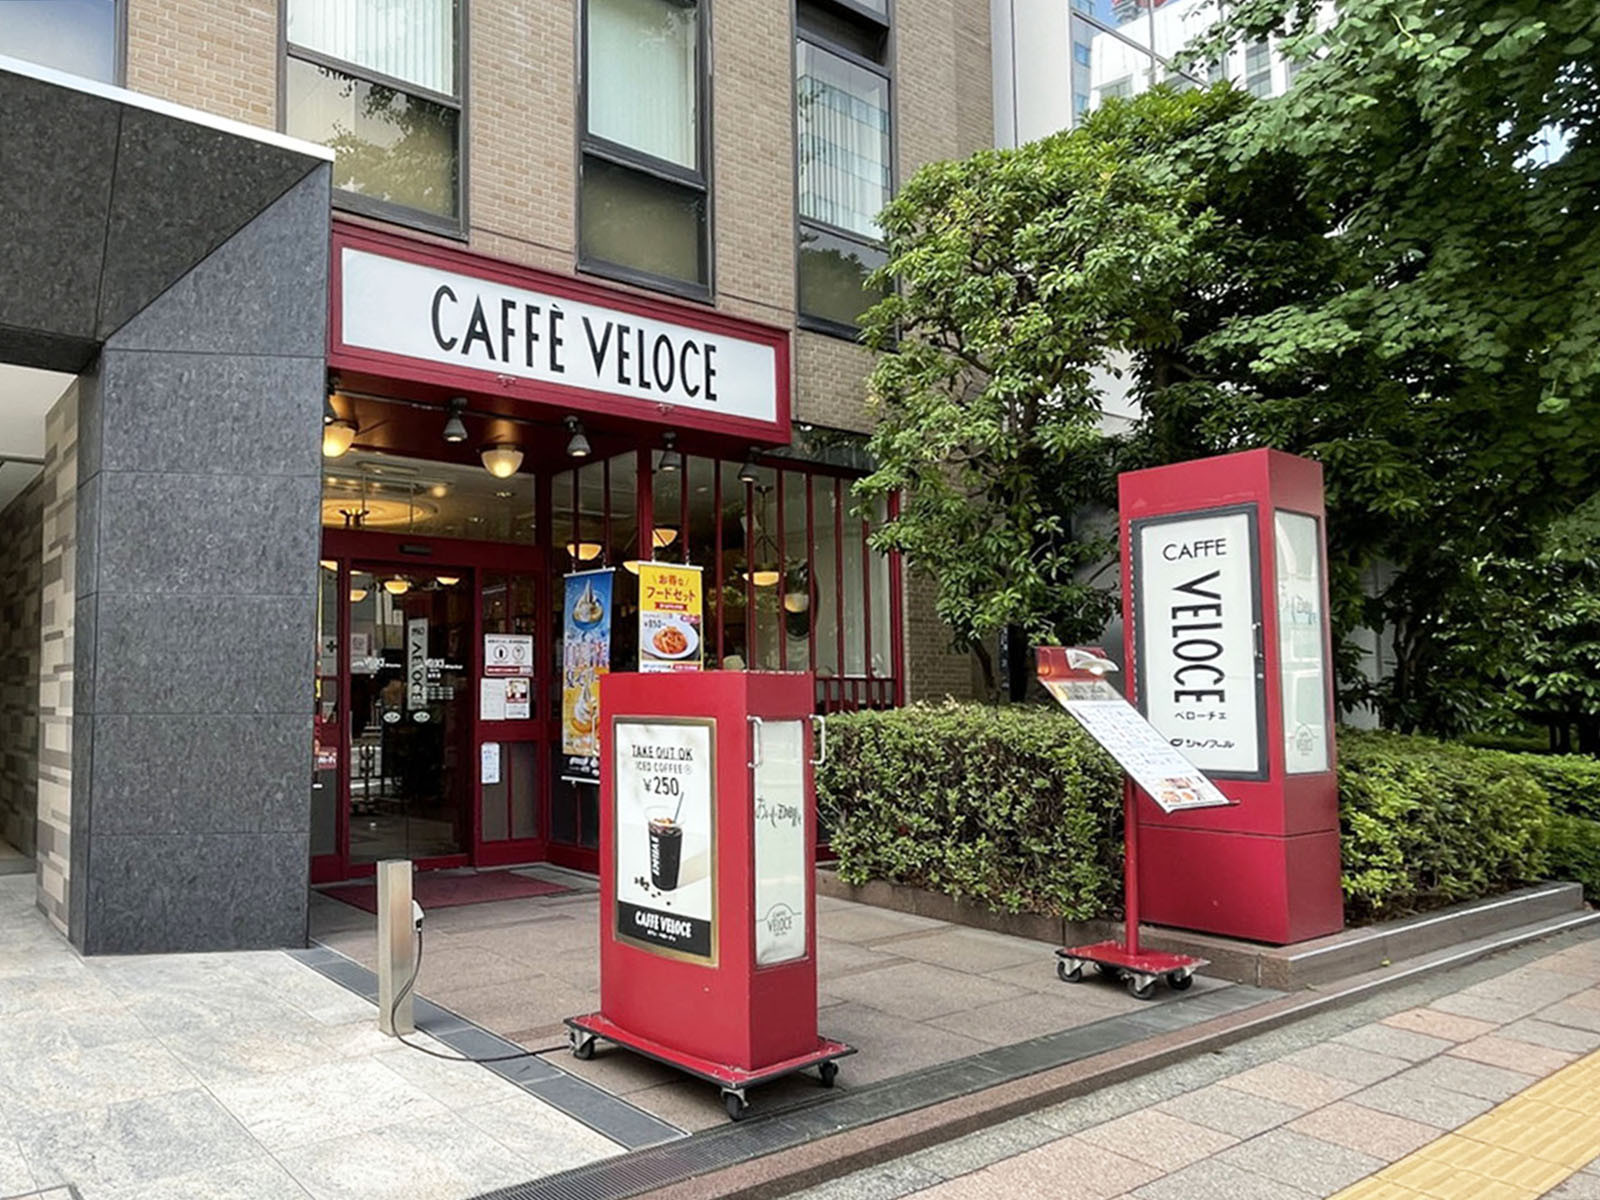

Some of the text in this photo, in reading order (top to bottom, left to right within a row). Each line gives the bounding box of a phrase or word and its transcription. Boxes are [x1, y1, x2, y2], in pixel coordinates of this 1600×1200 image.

[431, 284, 717, 401] CAFFÈ VELOCE
[1162, 538, 1227, 562] CAFFE
[646, 586, 696, 603] フードセット
[1171, 569, 1226, 704] VELOCE
[632, 744, 693, 761] TAKE OUT OK
[654, 761, 683, 775] COFFEE
[642, 775, 680, 797] ¥250
[660, 916, 693, 939] VELOCE
